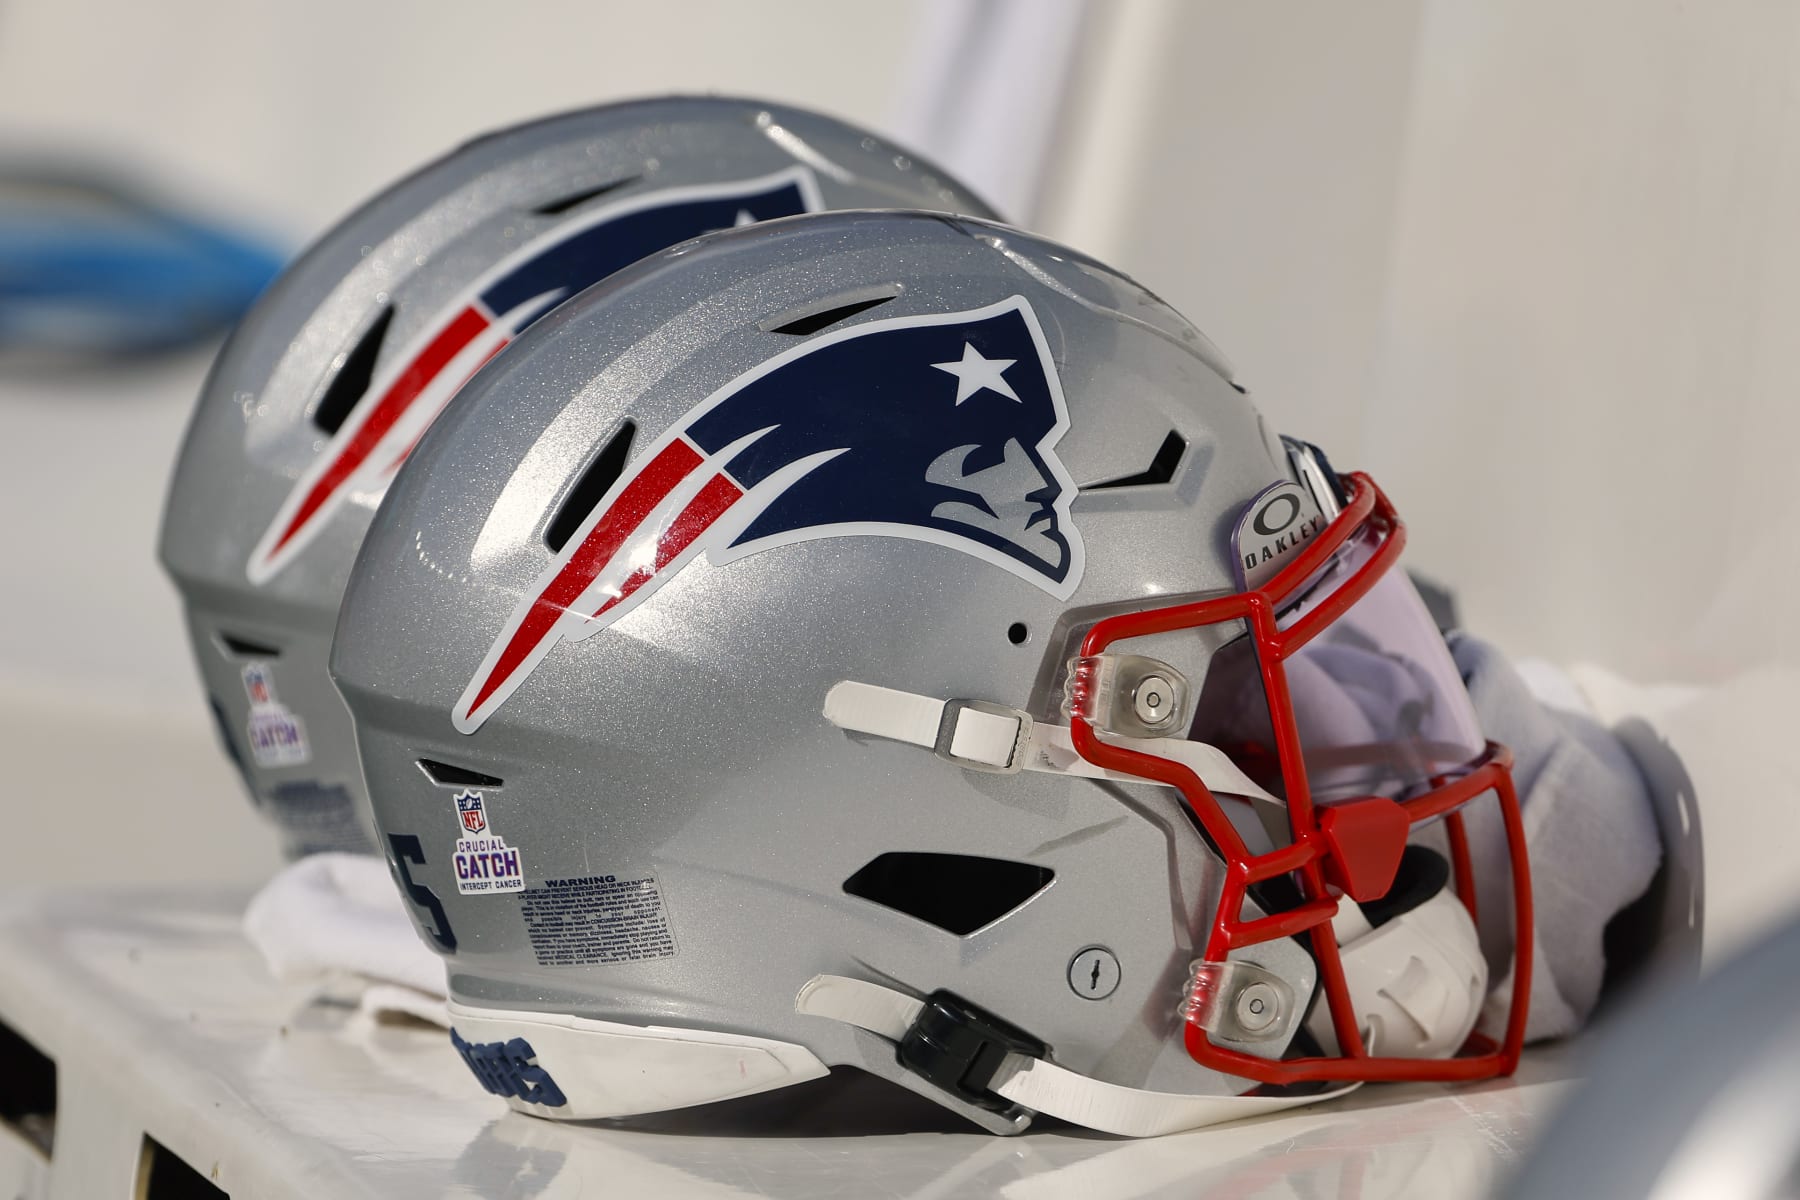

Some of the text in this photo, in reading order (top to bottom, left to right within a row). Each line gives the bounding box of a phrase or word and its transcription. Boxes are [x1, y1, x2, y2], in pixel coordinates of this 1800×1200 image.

[1245, 516, 1319, 570] OAKLEY
[462, 811, 485, 830] NFL
[458, 839, 505, 853] CRUCIAL
[455, 850, 520, 880] CATCH
[459, 879, 522, 891] INTERCEPT CANCER
[545, 875, 616, 888] WARNING
